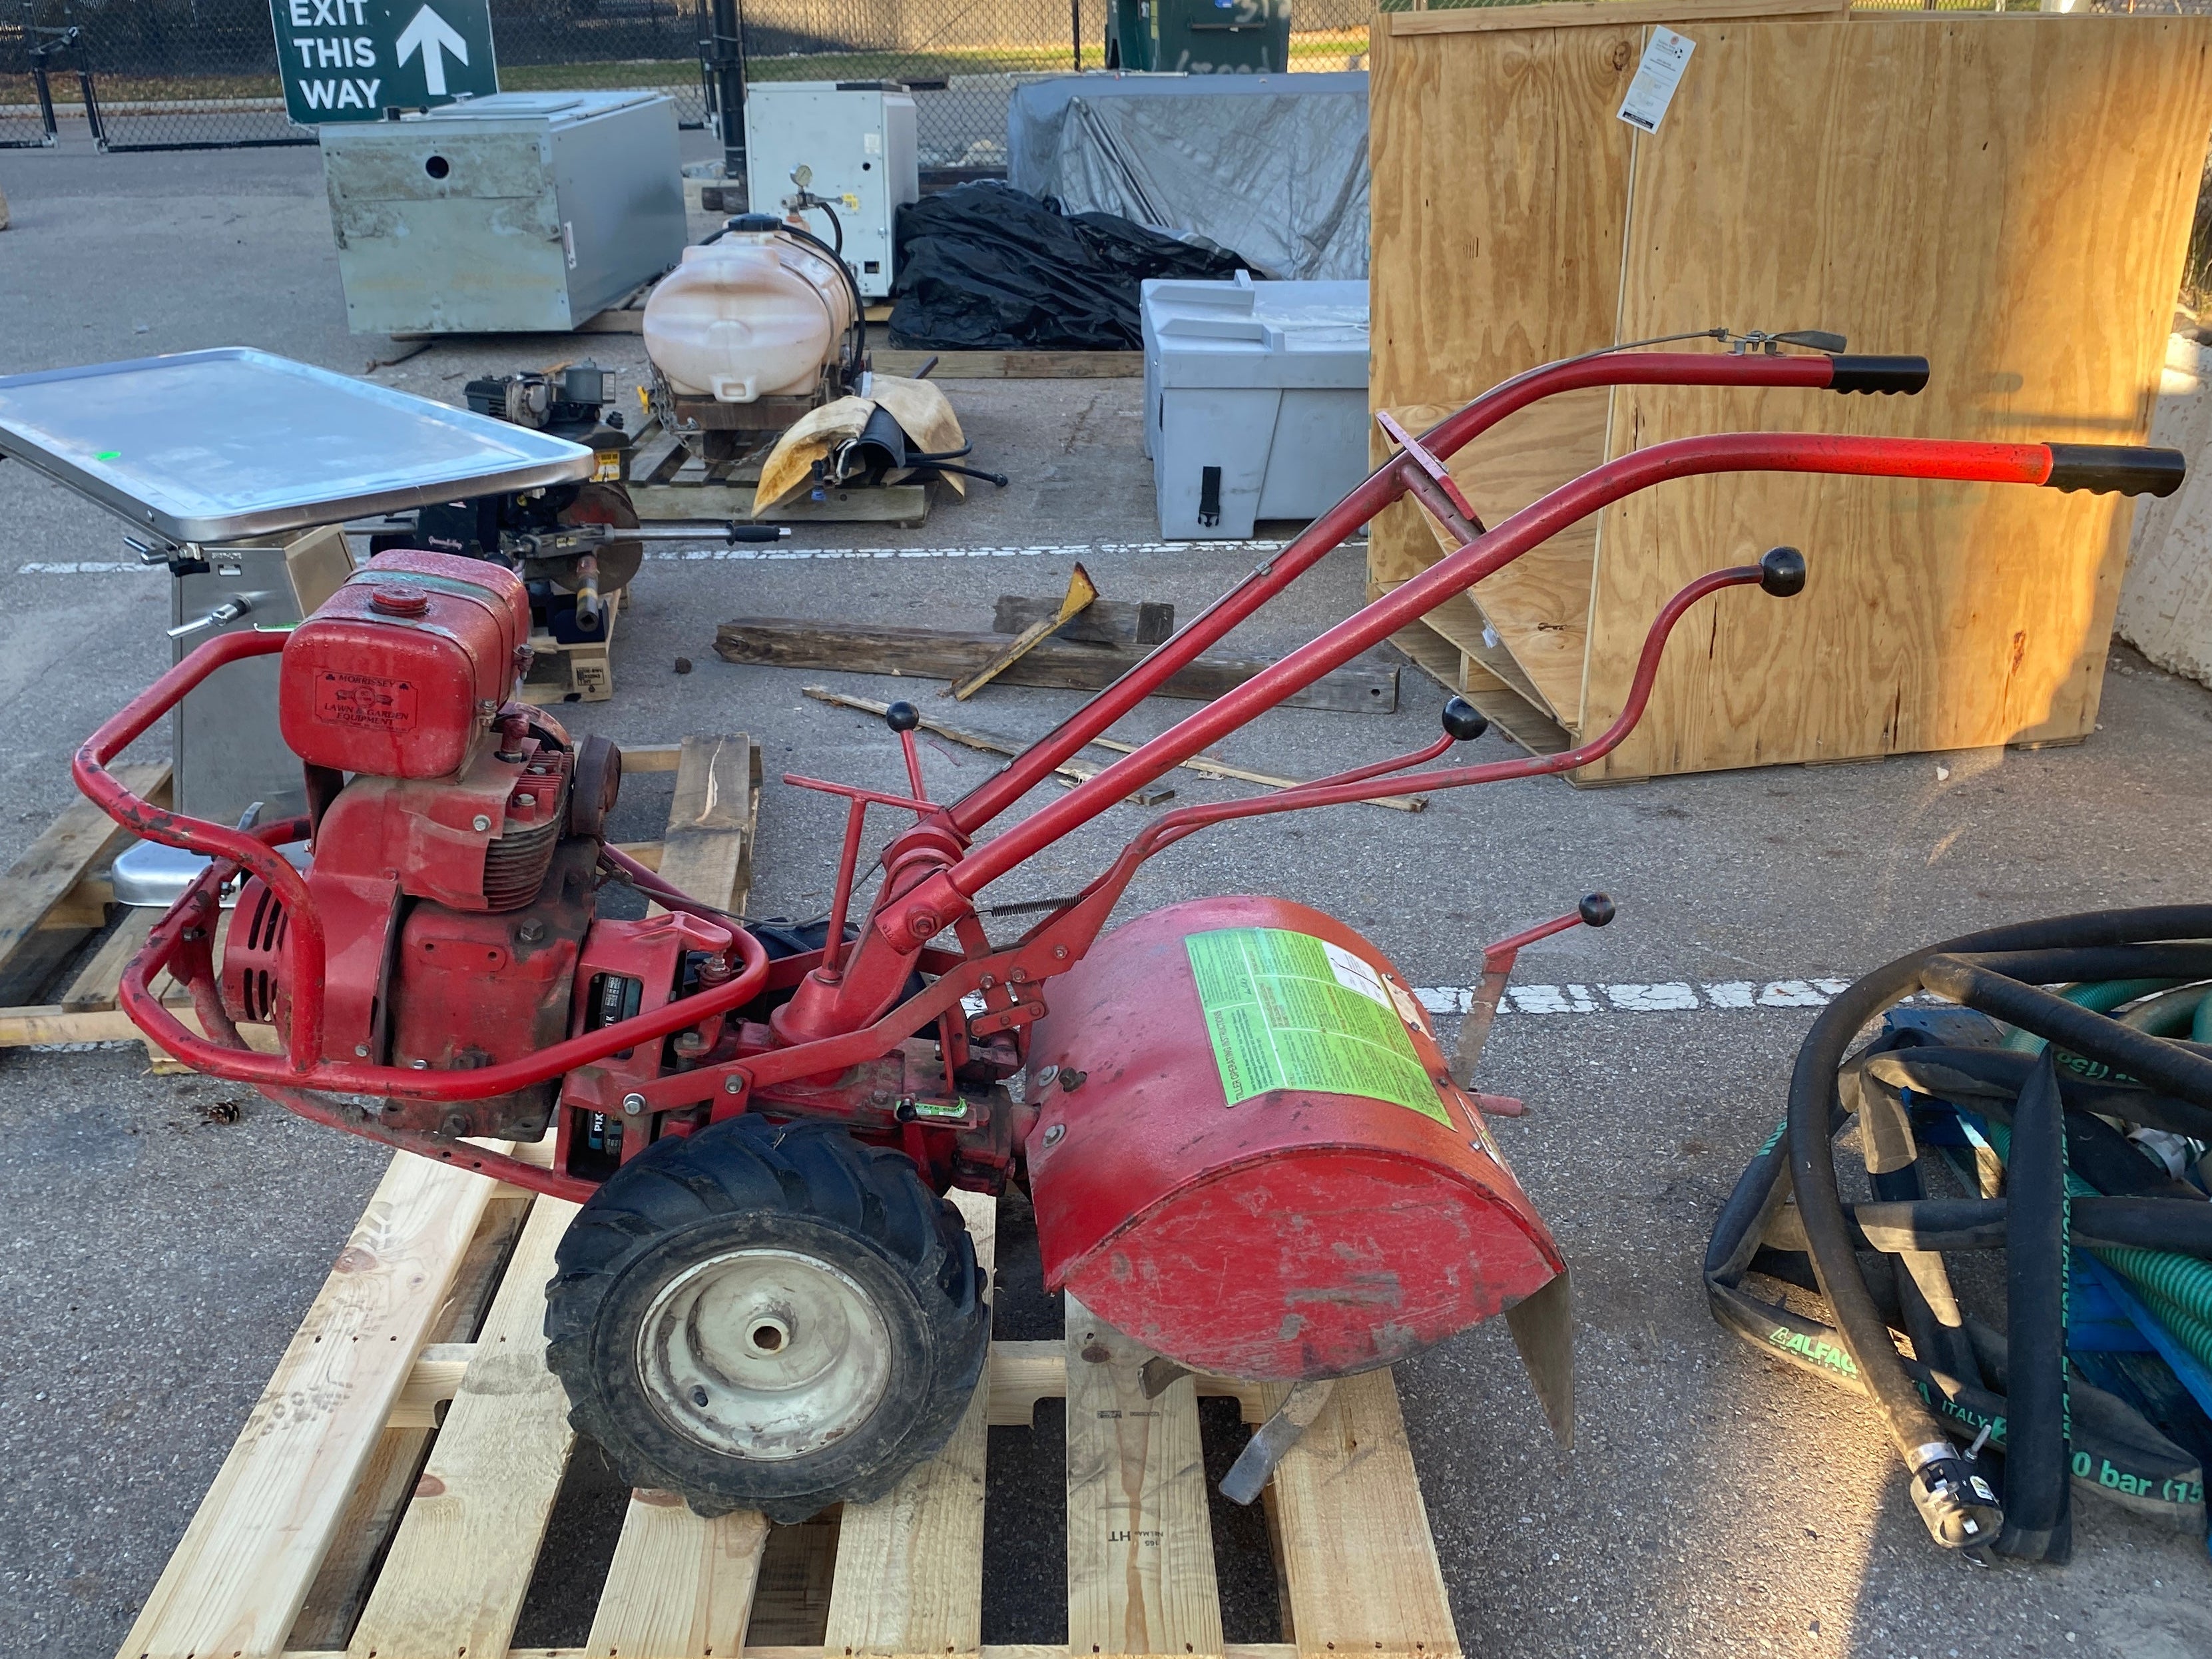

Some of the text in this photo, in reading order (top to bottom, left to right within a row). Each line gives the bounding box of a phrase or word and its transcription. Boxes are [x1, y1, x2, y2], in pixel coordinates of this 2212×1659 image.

[289, 0, 367, 27] EXIT
[293, 37, 376, 68] THIS
[298, 78, 381, 110] WAY
[339, 675, 396, 687] MORRISSEY
[324, 703, 353, 713] LAWN
[366, 709, 409, 720] GARDEN
[337, 713, 393, 725] EQUIPMENT
[1213, 1010, 1244, 1101] TILLER OPERATING INSTRUCTIONS
[1942, 1400, 1988, 1429] ITALY
[2099, 1459, 2153, 1496] bar
[1108, 1531, 1131, 1542] HT
